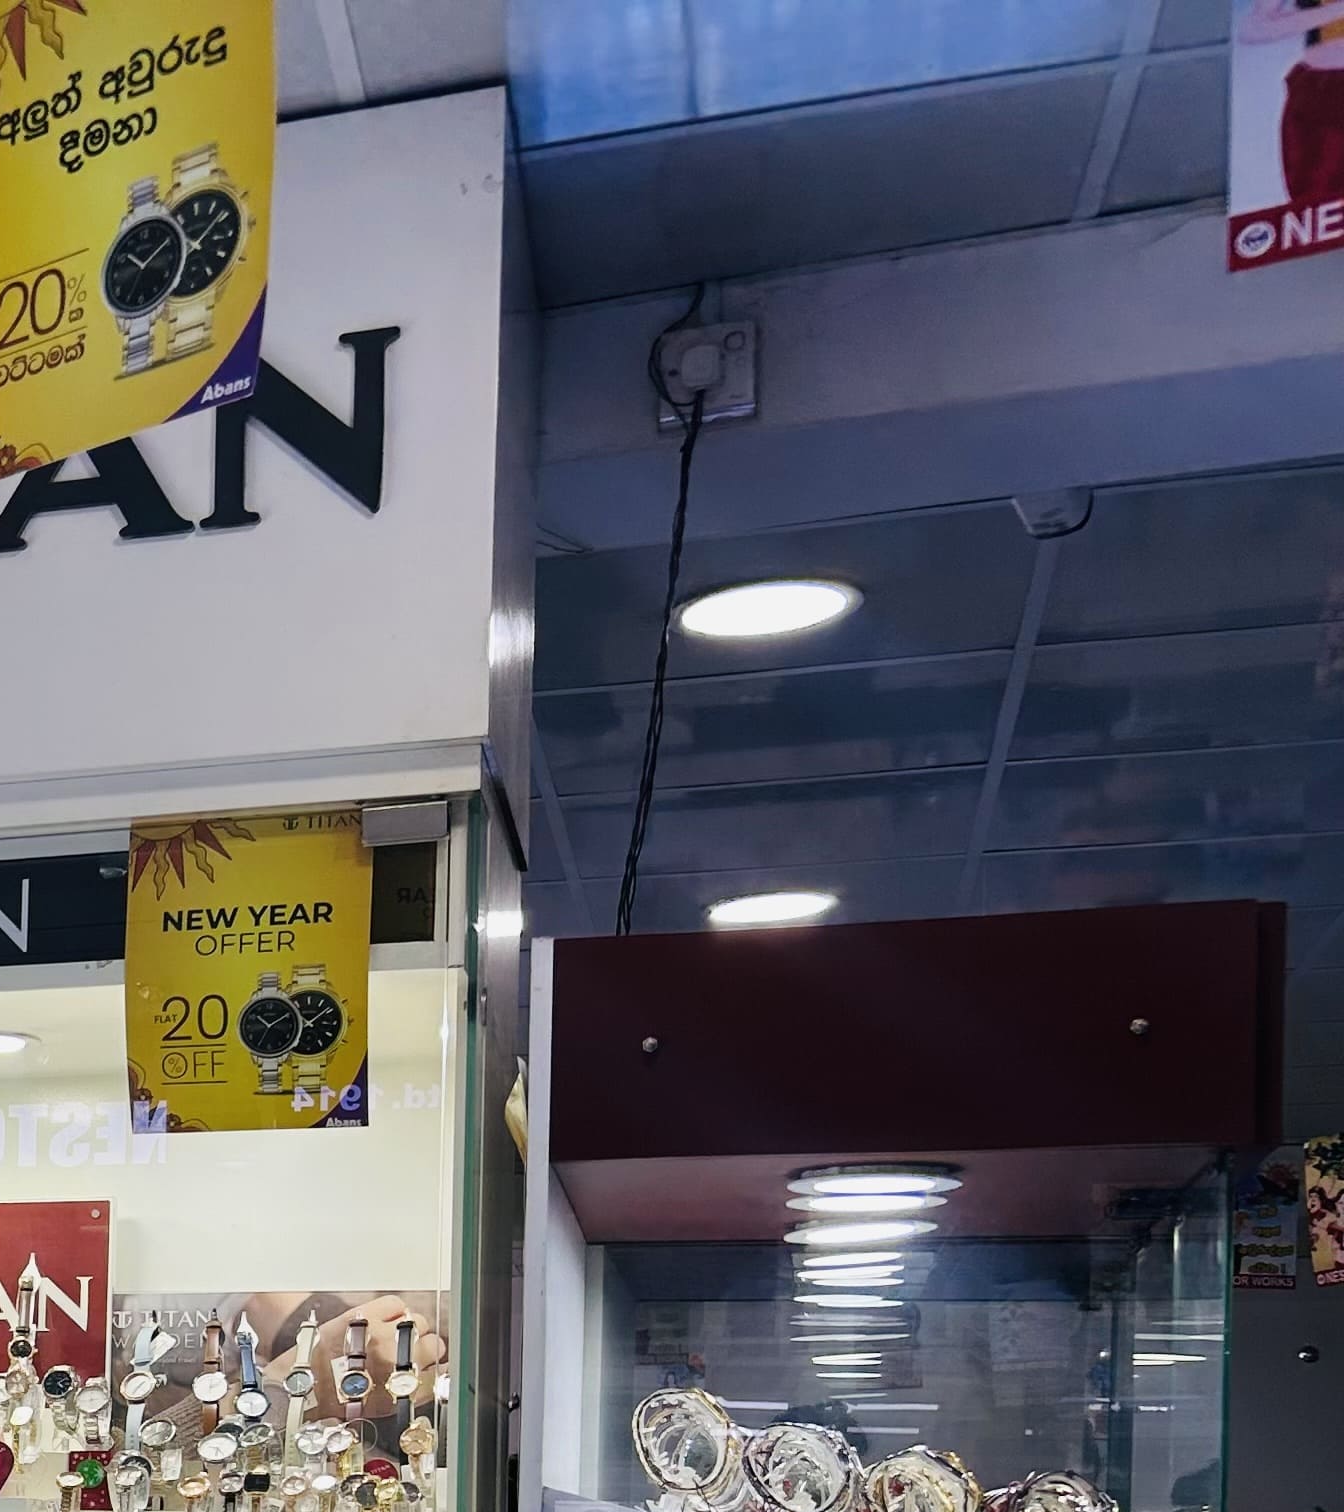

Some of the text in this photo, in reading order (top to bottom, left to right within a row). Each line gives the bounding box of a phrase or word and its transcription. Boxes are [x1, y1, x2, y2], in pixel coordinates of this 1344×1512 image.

[97, 24, 228, 104] අවුරුදු
[57, 106, 158, 174] දීමනා
[201, 374, 251, 404] Abans
[162, 902, 333, 933] NEW YEAR
[195, 931, 296, 956] OFFER
[153, 1014, 179, 1025] FLAT
[161, 994, 229, 1042] 20
[325, 1117, 362, 1128] Abans
